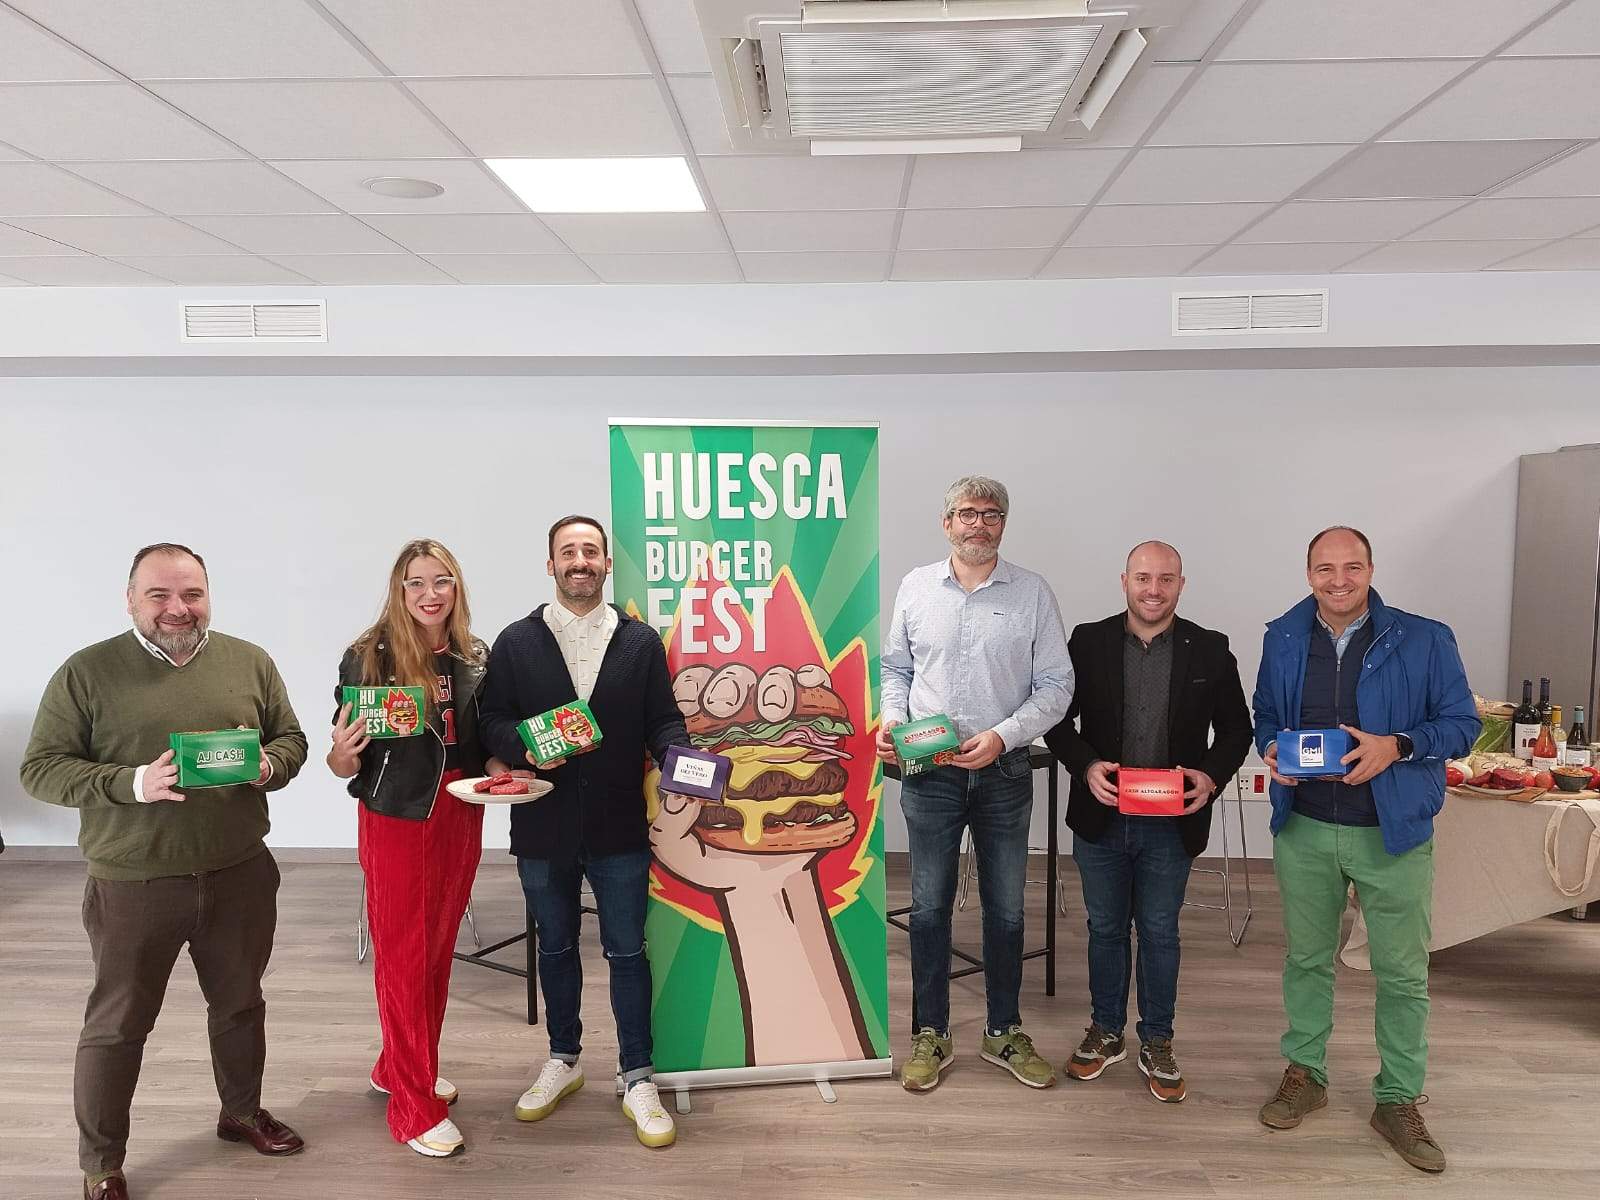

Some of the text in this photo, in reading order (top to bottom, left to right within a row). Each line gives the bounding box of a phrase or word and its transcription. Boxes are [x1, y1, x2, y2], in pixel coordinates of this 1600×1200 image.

[643, 452, 847, 520] HUESCA
[645, 540, 773, 582] BURGER
[647, 586, 773, 654] FEST
[359, 689, 376, 705] HU
[365, 719, 386, 734] EST
[527, 716, 546, 733] HU
[535, 727, 563, 745] BURGER
[197, 751, 211, 762] AJ
[538, 737, 567, 759] FEST
